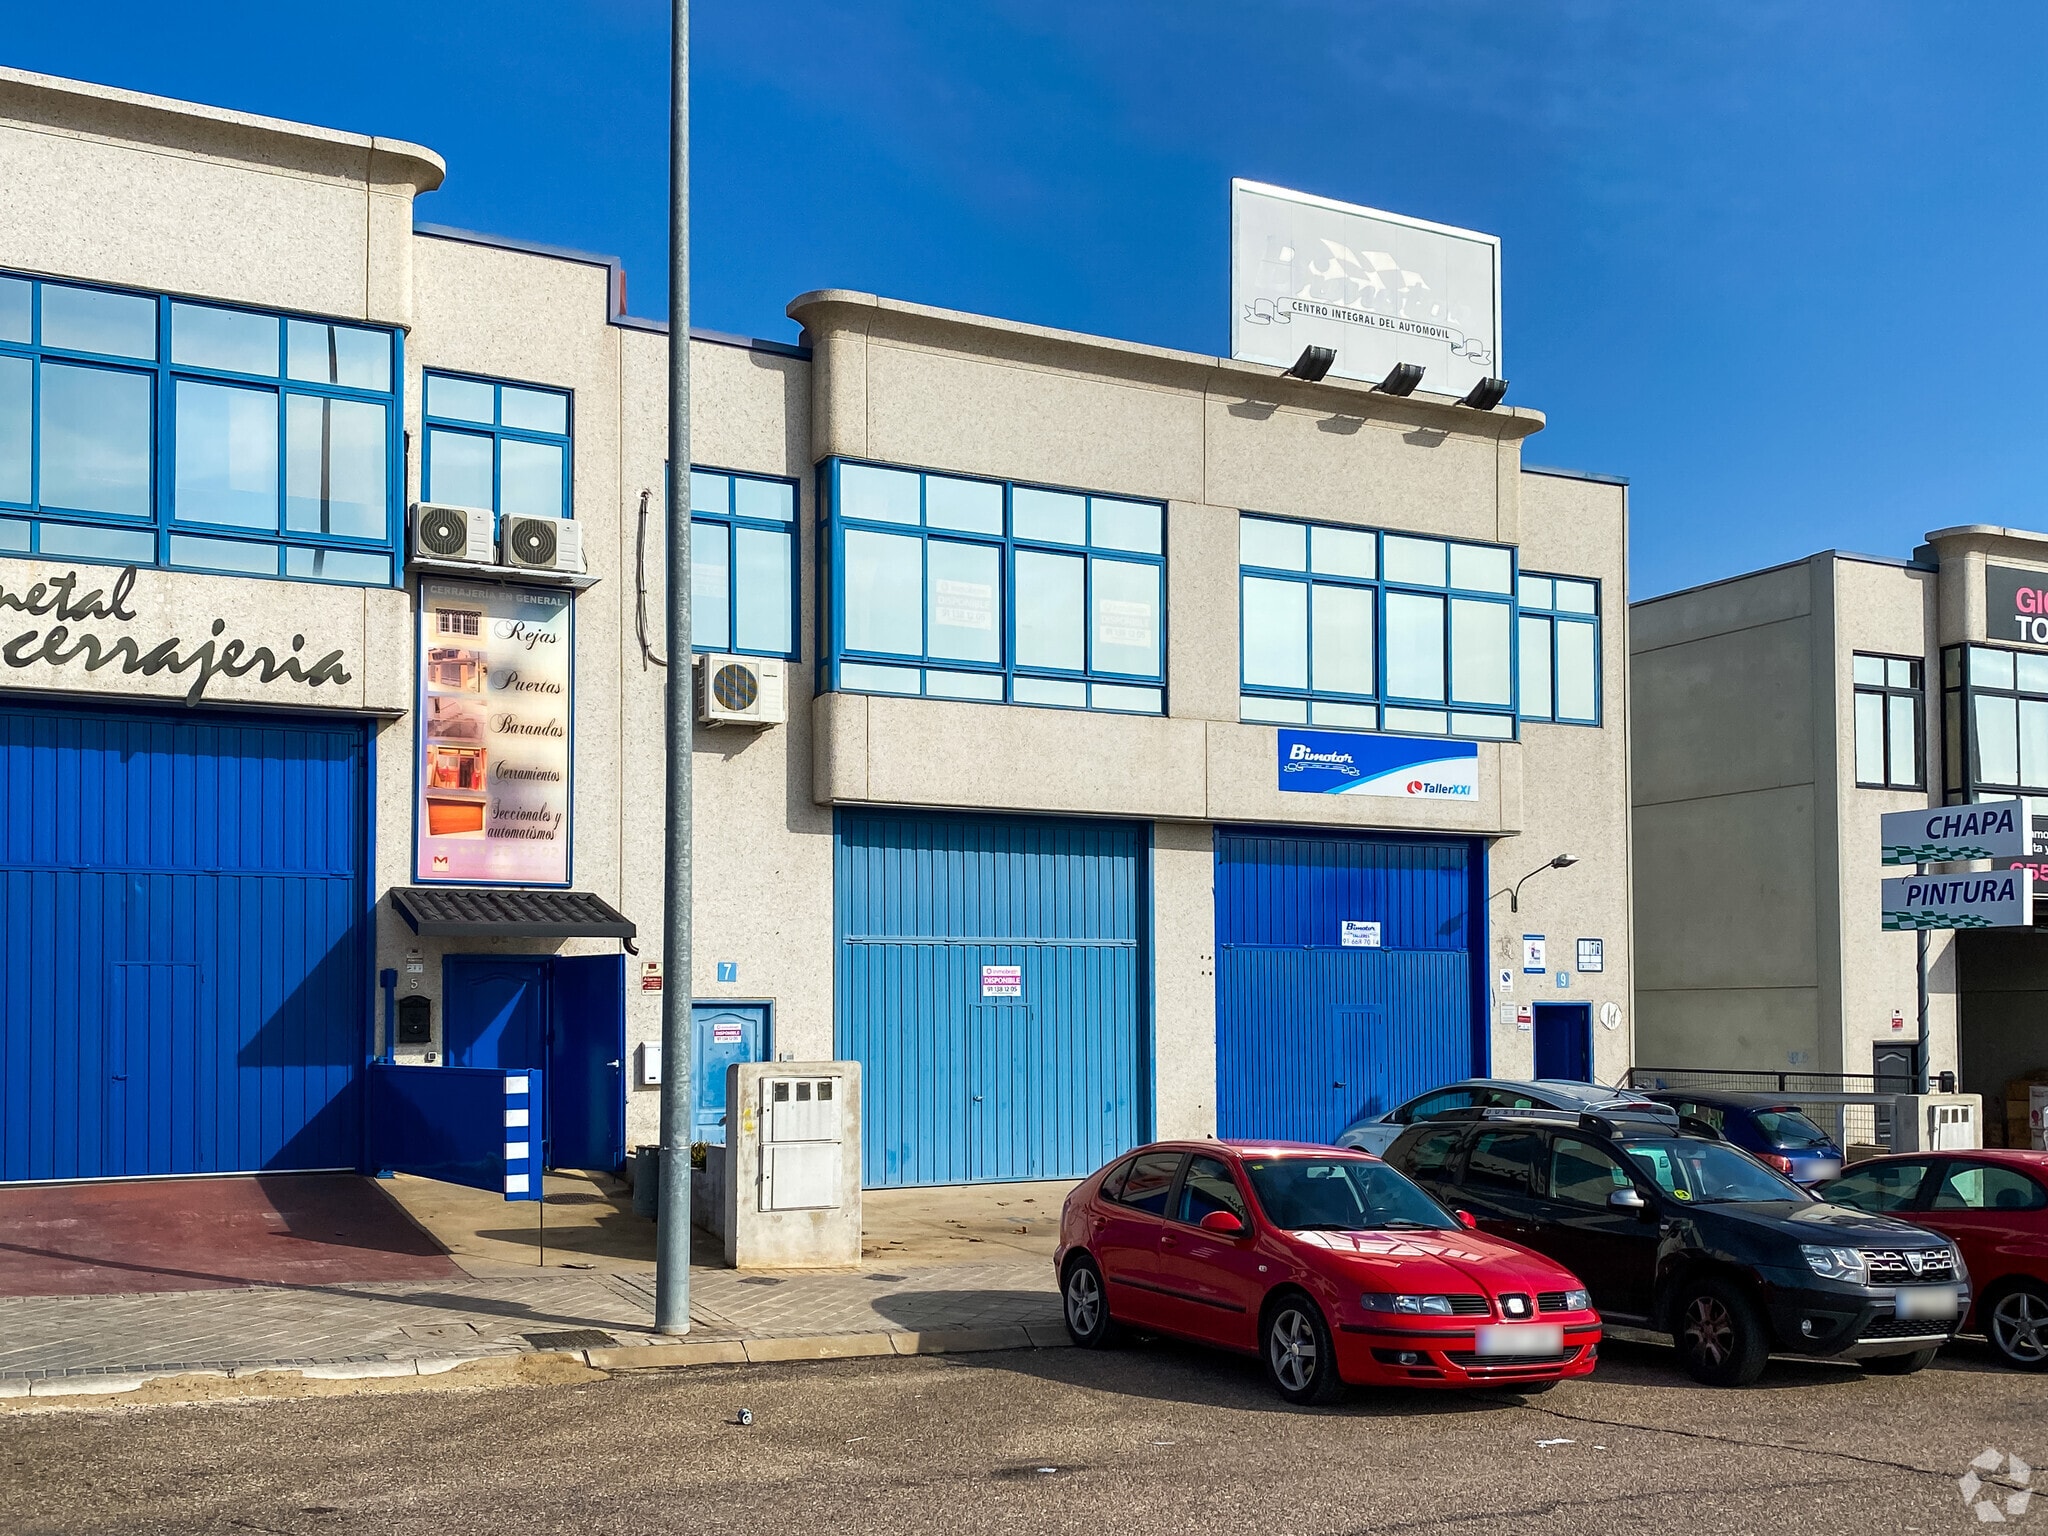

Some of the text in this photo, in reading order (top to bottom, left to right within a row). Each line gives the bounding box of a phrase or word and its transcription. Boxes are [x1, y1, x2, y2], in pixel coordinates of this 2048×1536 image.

[1292, 301, 1449, 339] CENTRO INTEGRAL DEL AUTOMOVIL
[501, 592, 513, 600] EN
[516, 594, 563, 606] GENERAL
[494, 620, 560, 650] Rejas
[2, 618, 352, 708] cerrajeria
[490, 668, 564, 694] Puertas
[490, 713, 565, 738] Barandas
[1289, 744, 1354, 763] Bimotor
[490, 760, 561, 785] Cerramientos
[1423, 783, 1471, 796] TallerXXI
[491, 798, 561, 830] Seccionales y
[1926, 809, 2014, 840] CHAPA
[487, 826, 555, 841] automatismos
[1906, 878, 2015, 907] PINTURA
[411, 978, 418, 989] 5
[723, 964, 732, 980] 7
[1560, 973, 1566, 987] 9
[1486, 1108, 1535, 1116] DUSTER
